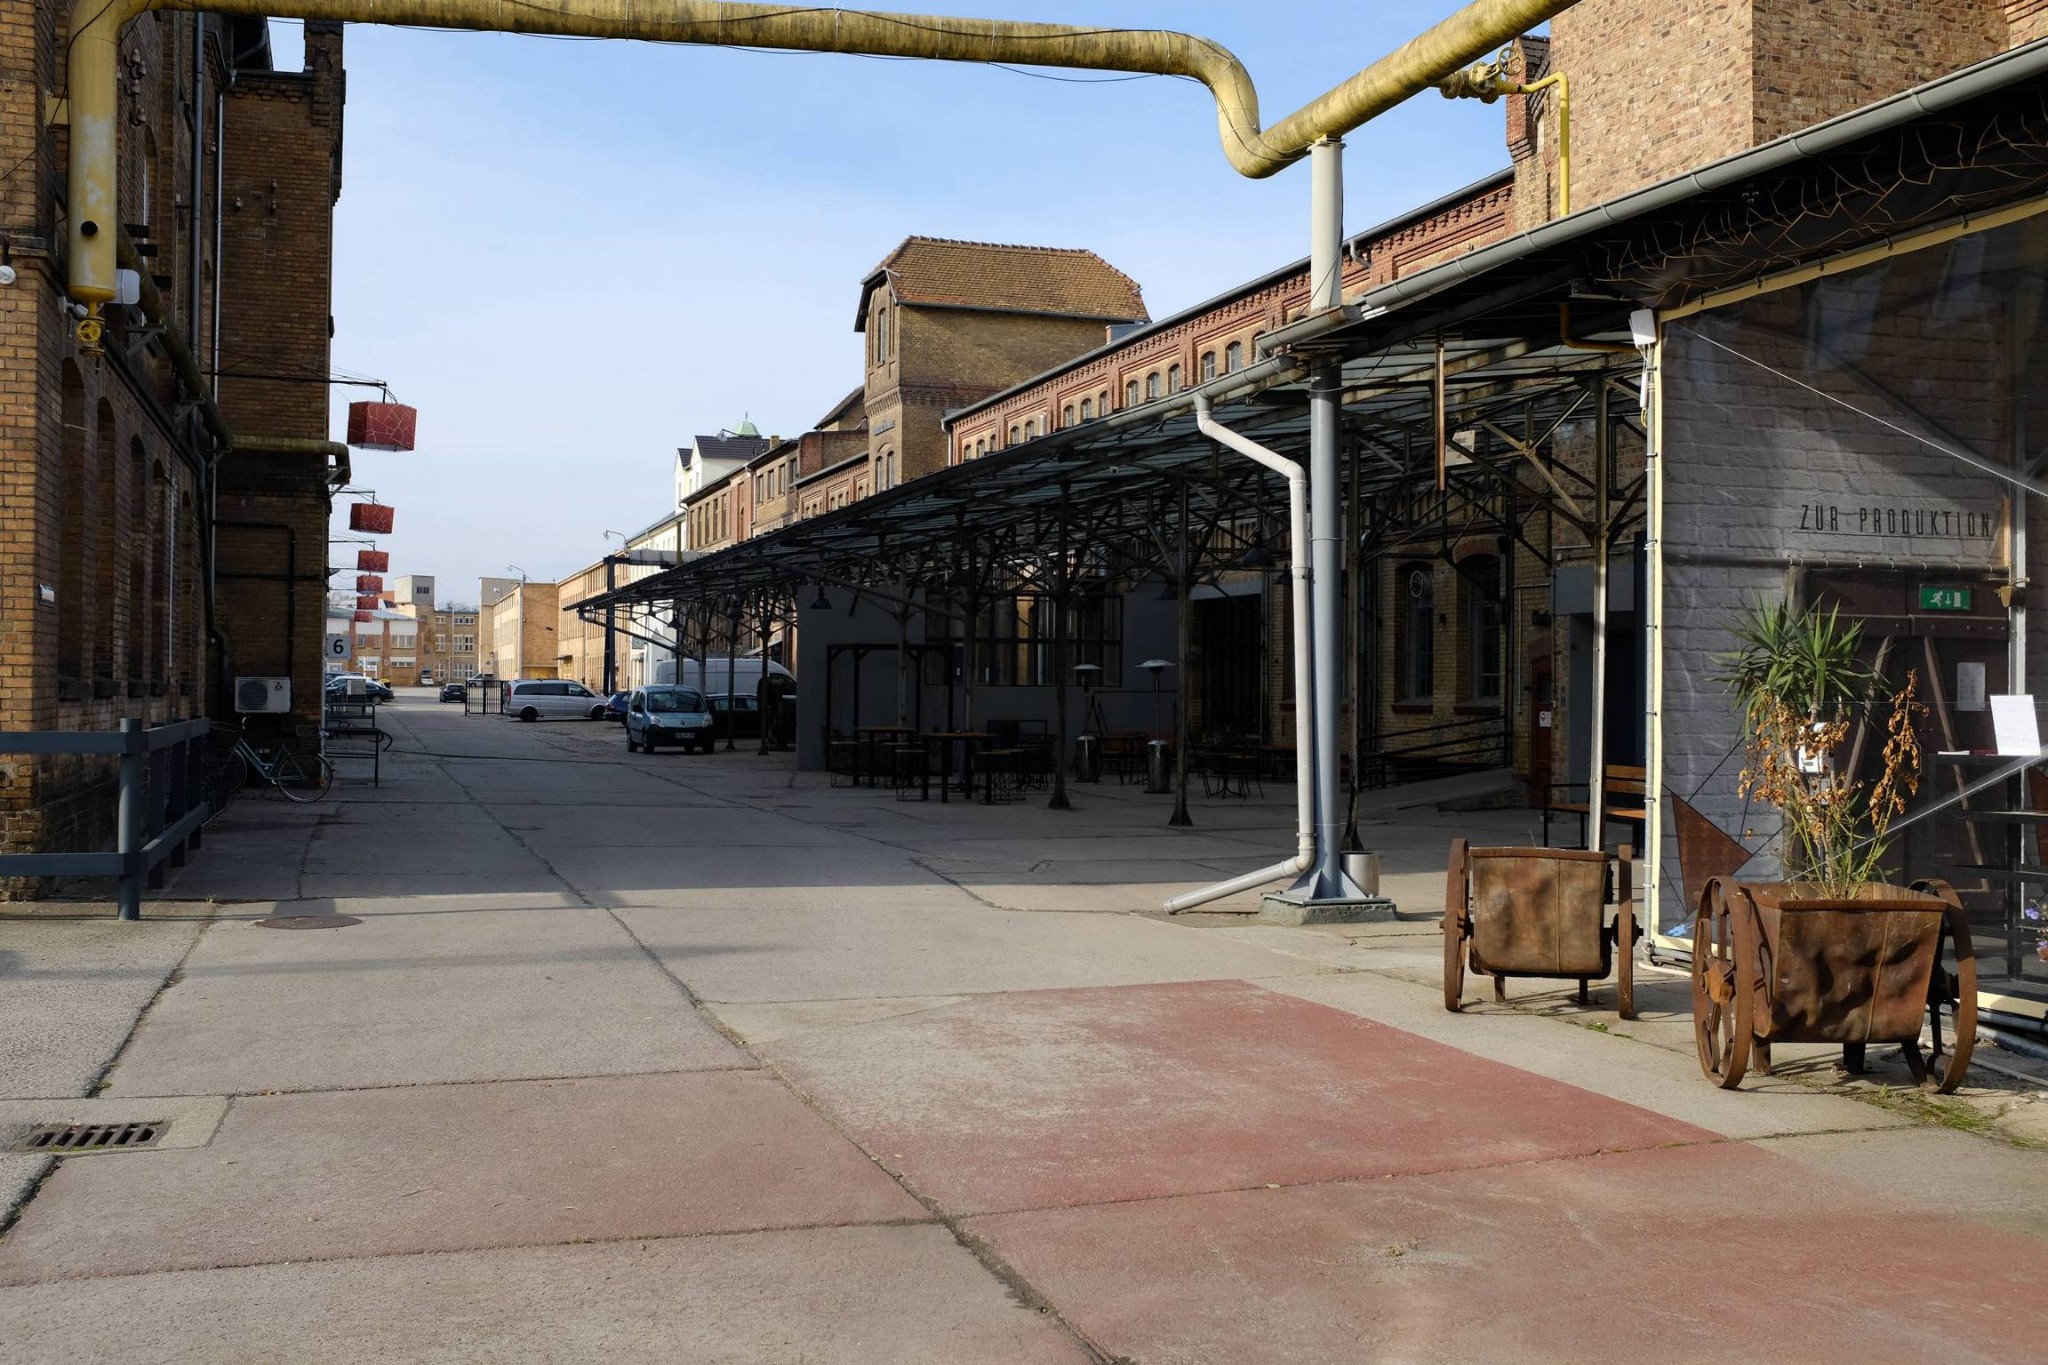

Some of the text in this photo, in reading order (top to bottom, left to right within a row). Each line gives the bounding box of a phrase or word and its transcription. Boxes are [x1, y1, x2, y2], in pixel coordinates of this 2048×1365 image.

[1800, 504, 1990, 538] ZUR PRODUKTION
[333, 638, 344, 655] 6
